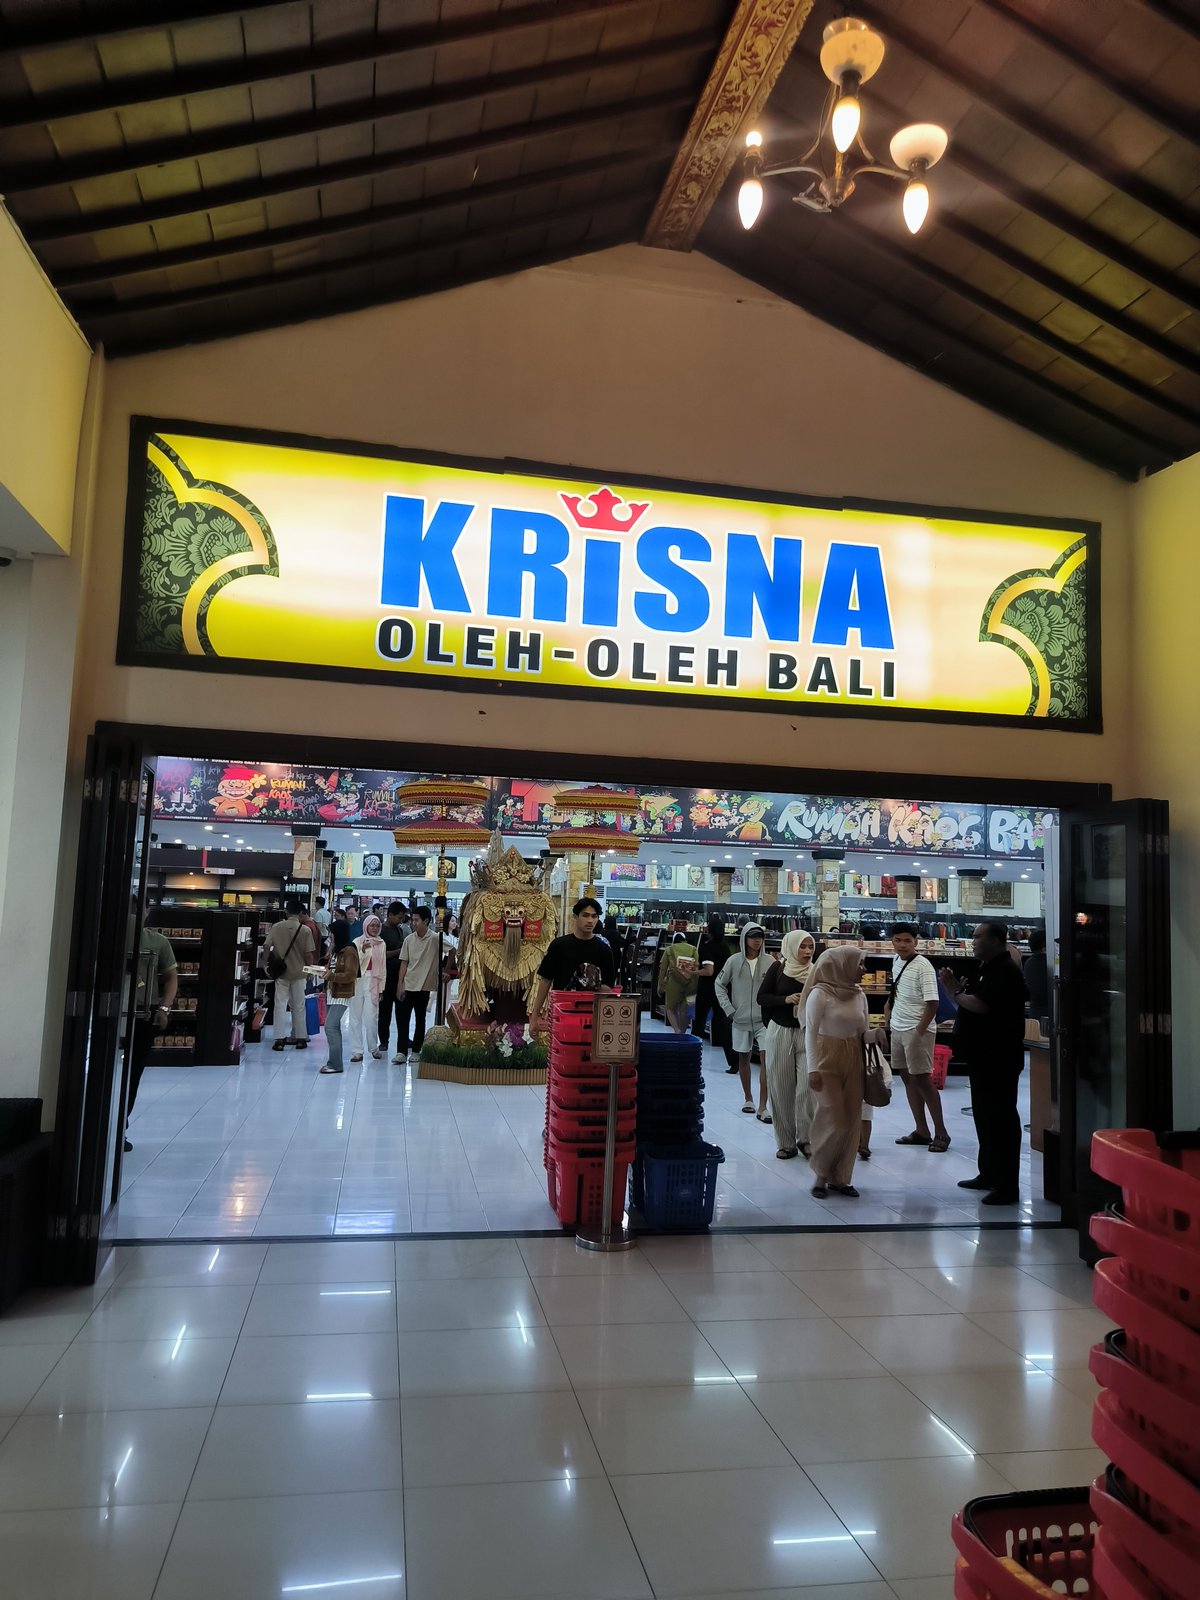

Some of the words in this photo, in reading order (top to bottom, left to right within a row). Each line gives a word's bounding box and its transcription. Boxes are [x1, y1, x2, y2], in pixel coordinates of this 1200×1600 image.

[378, 619, 738, 687] OLEH-OLEH
[767, 653, 895, 698] BALI
[270, 778, 306, 789] RUMAH
[269, 789, 292, 799] KAOS
[364, 788, 396, 802] RUMAH
[777, 800, 881, 842] RUMAH
[888, 805, 982, 848] KAOS
